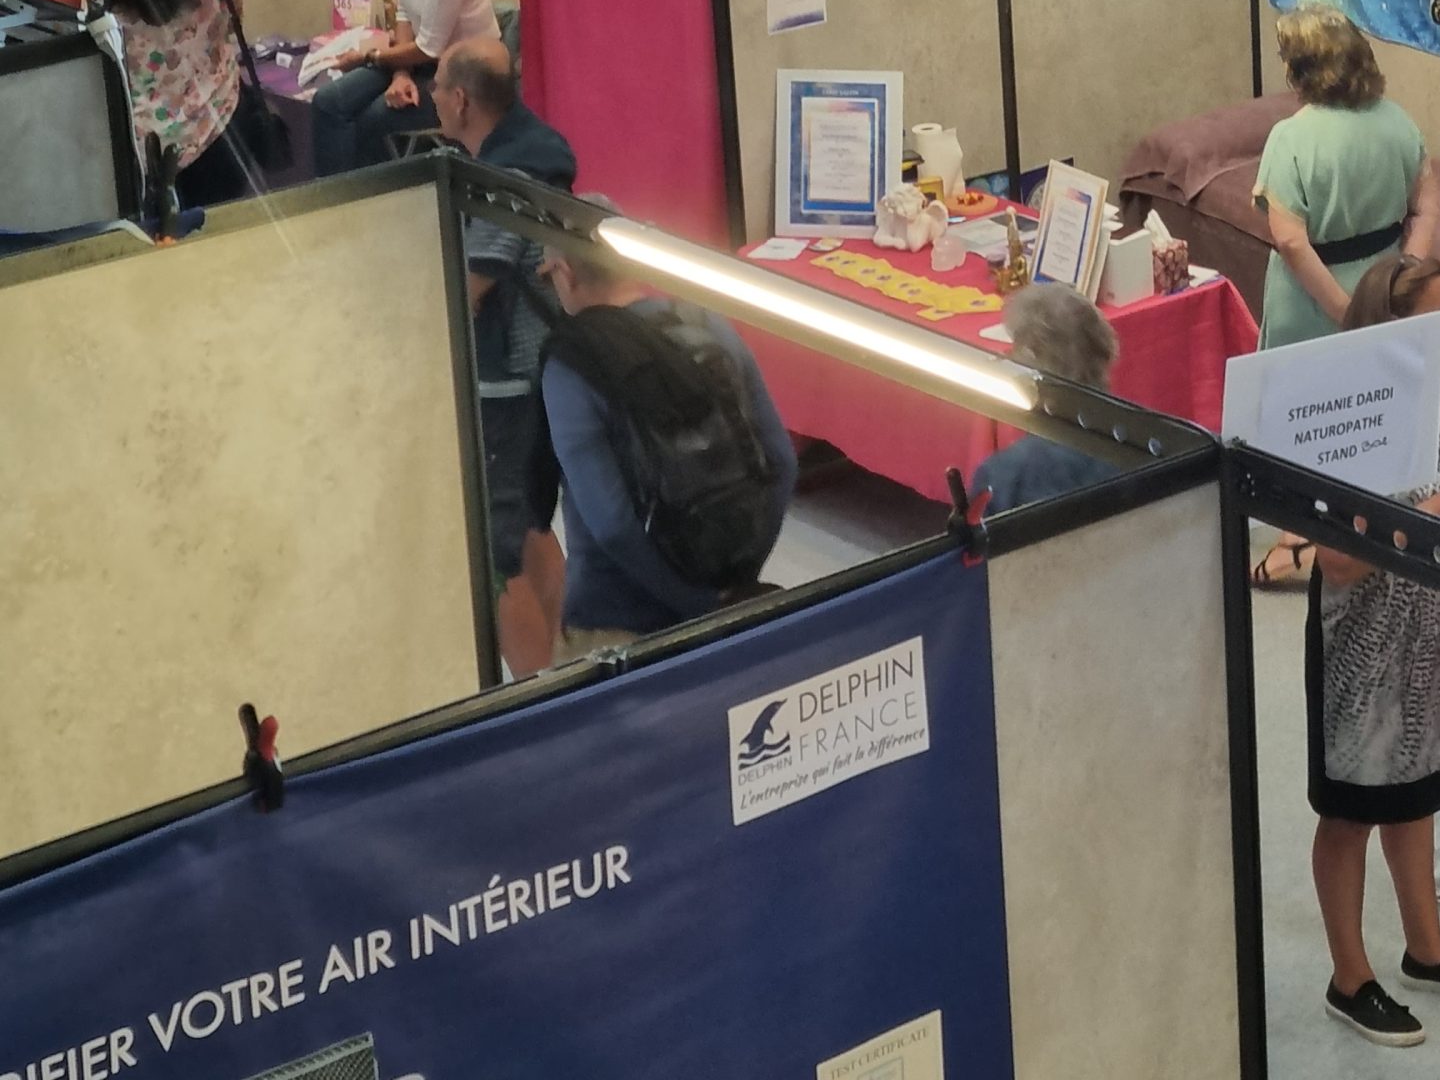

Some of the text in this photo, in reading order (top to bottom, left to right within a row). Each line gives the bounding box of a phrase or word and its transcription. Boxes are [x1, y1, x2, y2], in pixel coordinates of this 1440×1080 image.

[1288, 387, 1394, 422] STEPHANIE DARDI
[1294, 413, 1385, 445] NATUROPATHE
[1318, 445, 1358, 466] STAND
[799, 651, 914, 724] DELPHIN
[800, 691, 917, 761] FRANCE
[737, 756, 793, 786] DELPHIN
[740, 728, 925, 811] L'entreprise qui fait la différence
[148, 845, 633, 1053] VOTRE AIR INTÉRIEUR
